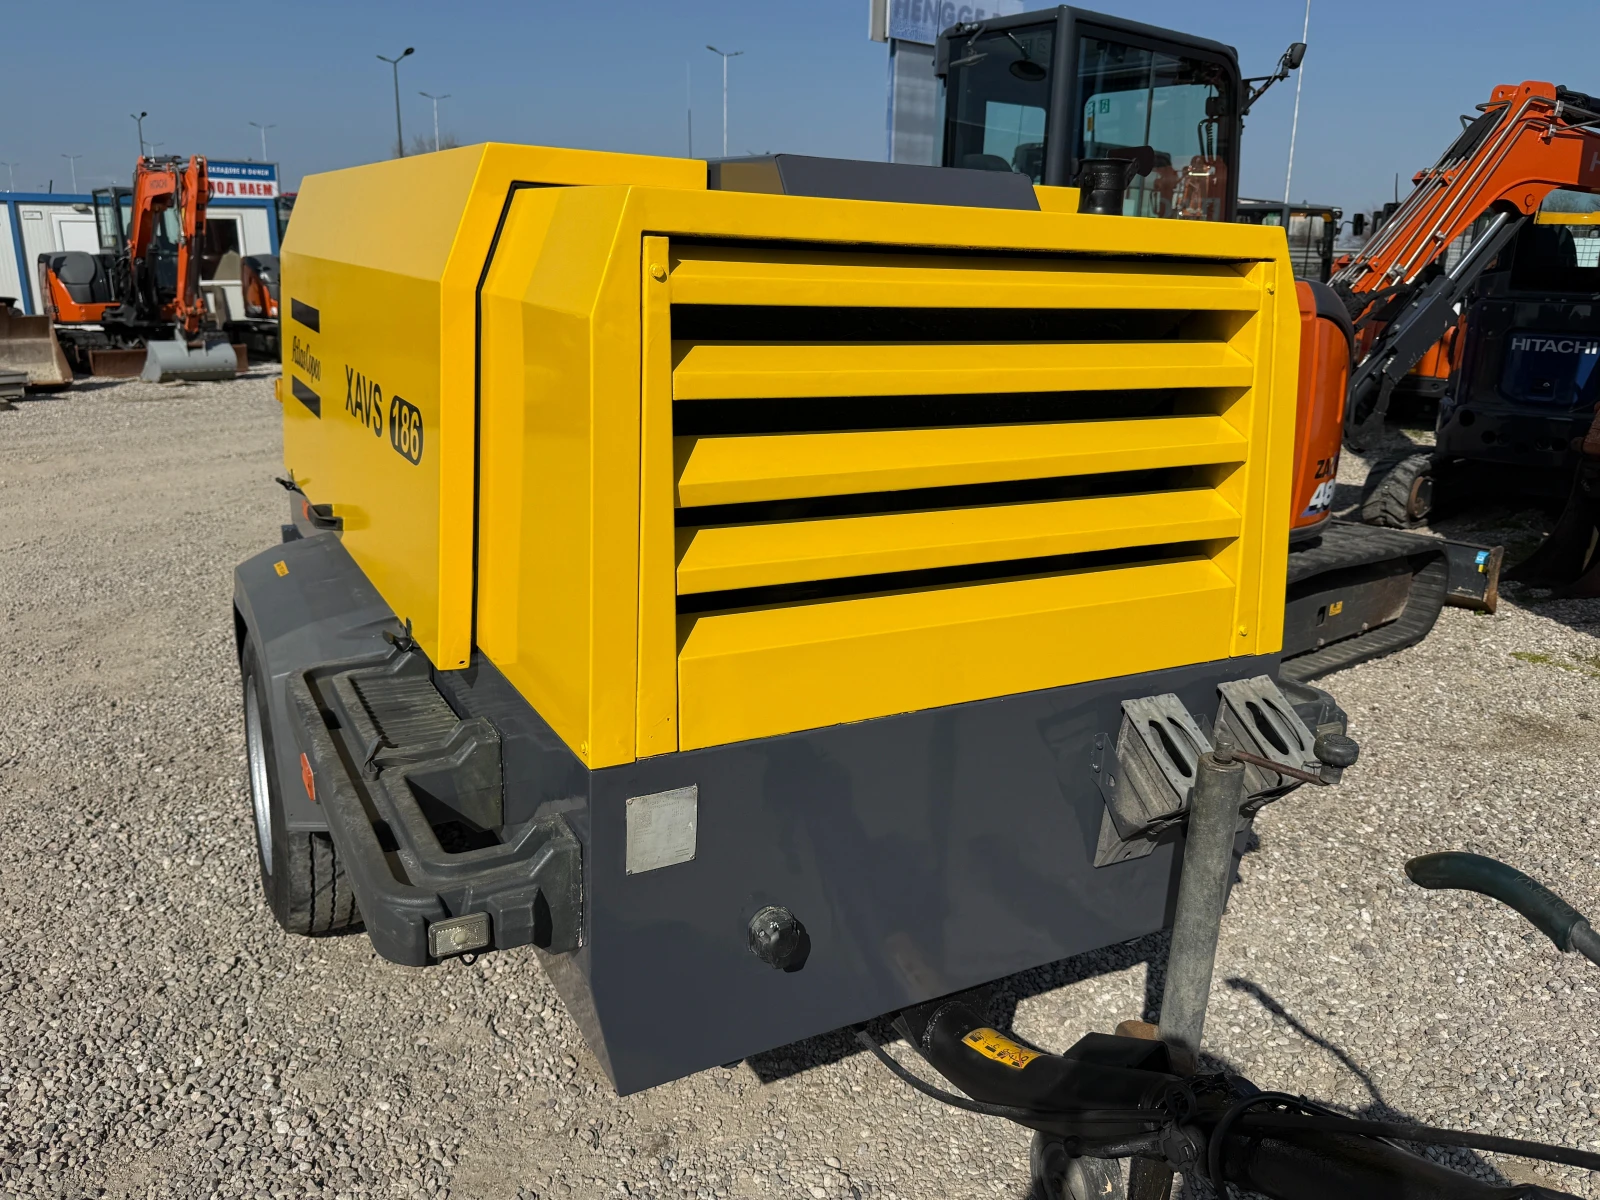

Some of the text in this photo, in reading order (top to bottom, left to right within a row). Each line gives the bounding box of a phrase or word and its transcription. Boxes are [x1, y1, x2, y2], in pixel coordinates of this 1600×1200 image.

[239, 182, 273, 196] НАЕМ
[1511, 338, 1598, 355] HITACHI
[345, 364, 420, 461] XAVS 186
